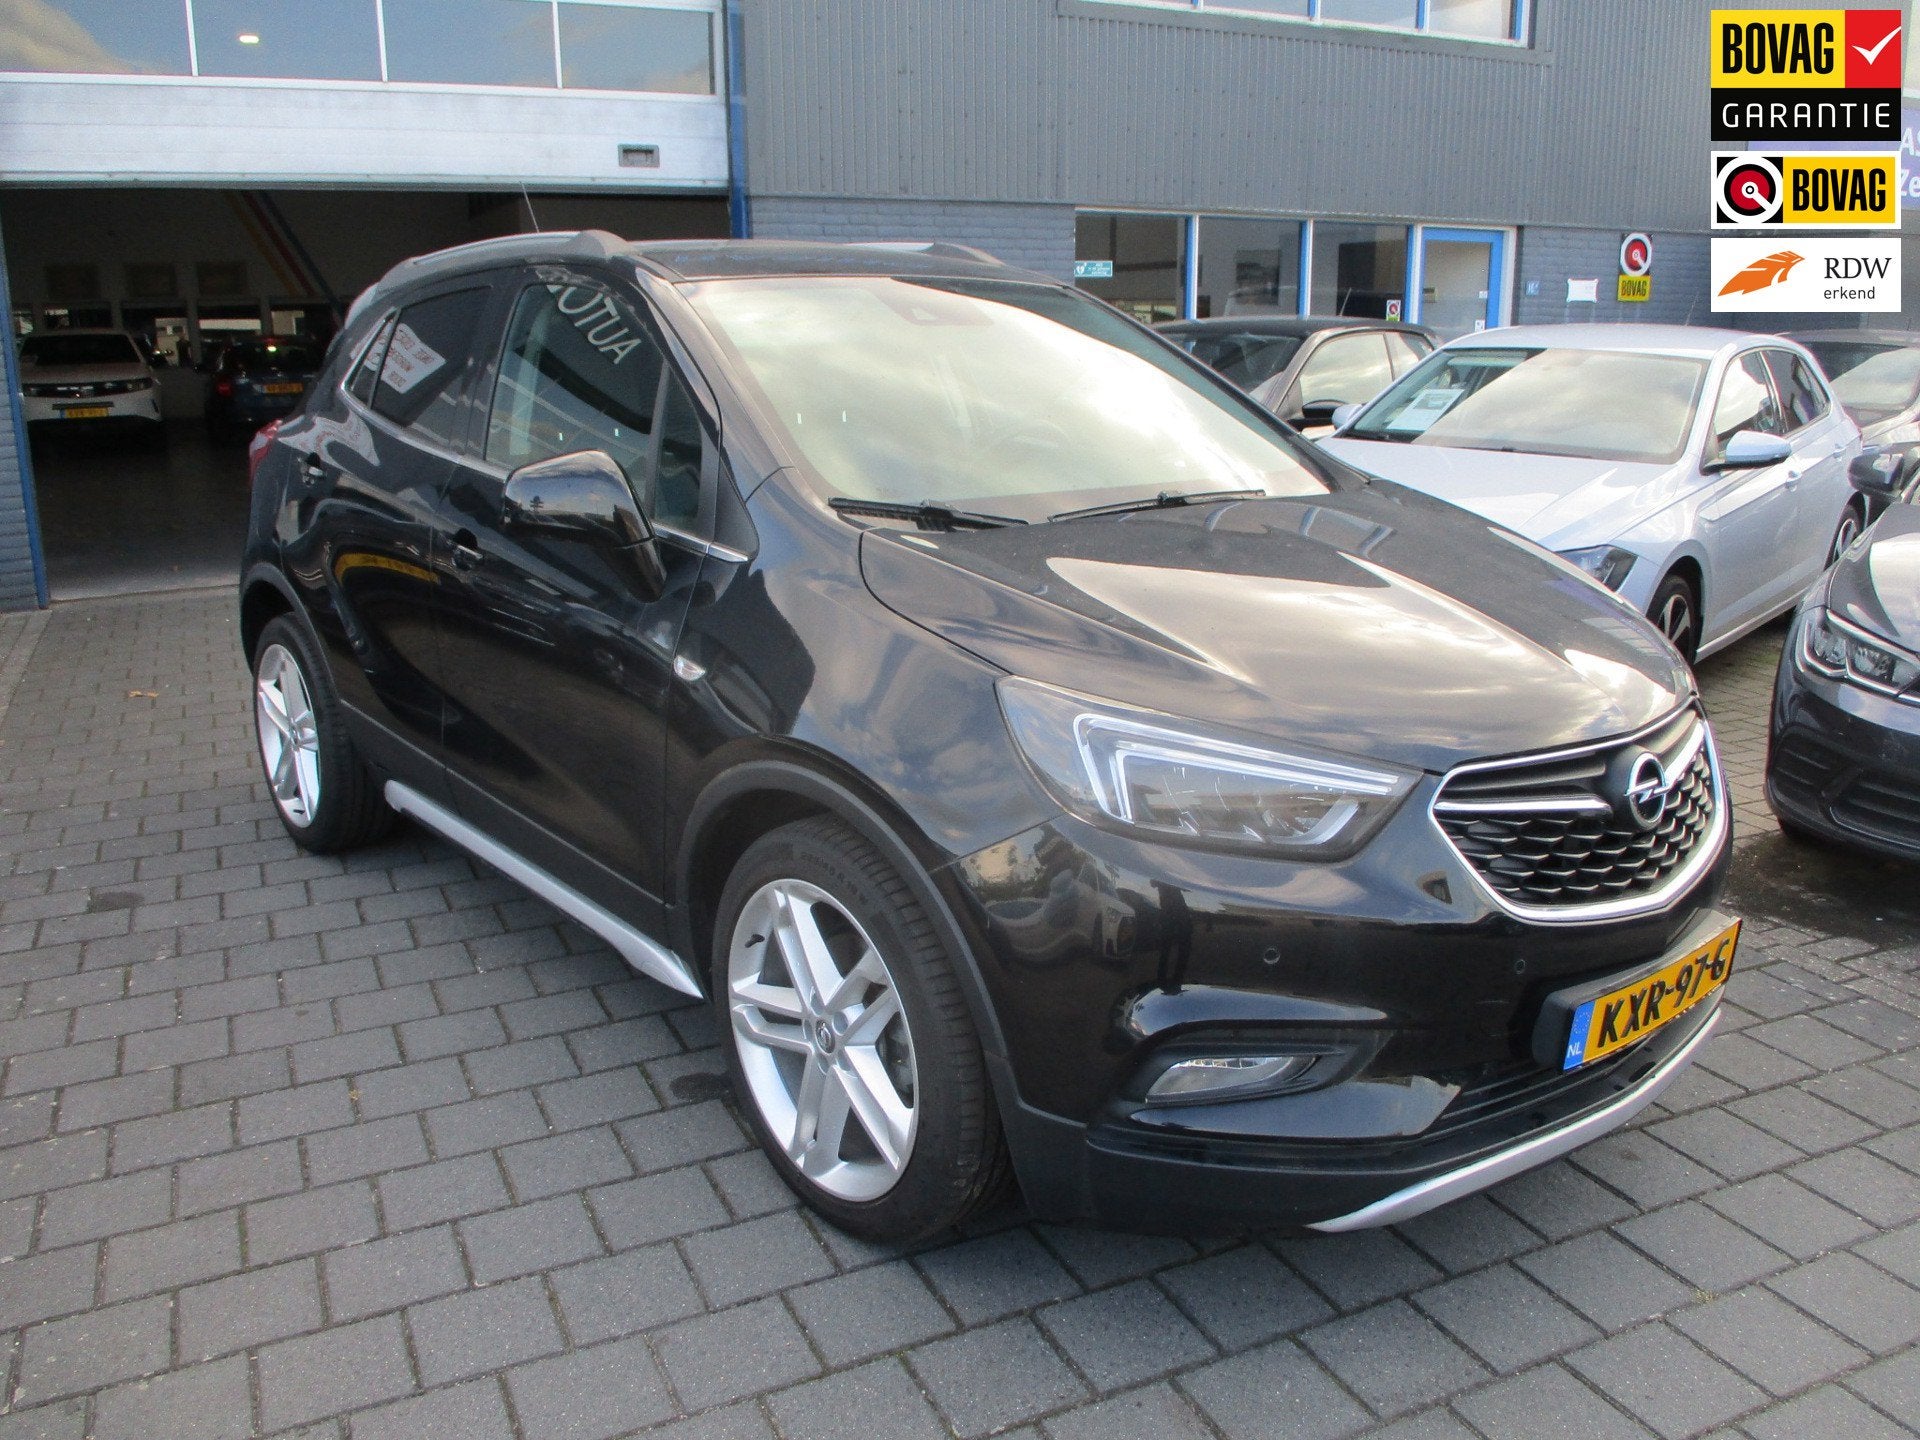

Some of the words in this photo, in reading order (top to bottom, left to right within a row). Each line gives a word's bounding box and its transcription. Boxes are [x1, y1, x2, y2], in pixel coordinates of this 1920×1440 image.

[1899, 127, 1920, 157] A
[1620, 280, 1648, 297] BOVAG
[1566, 1042, 1583, 1059] NL
